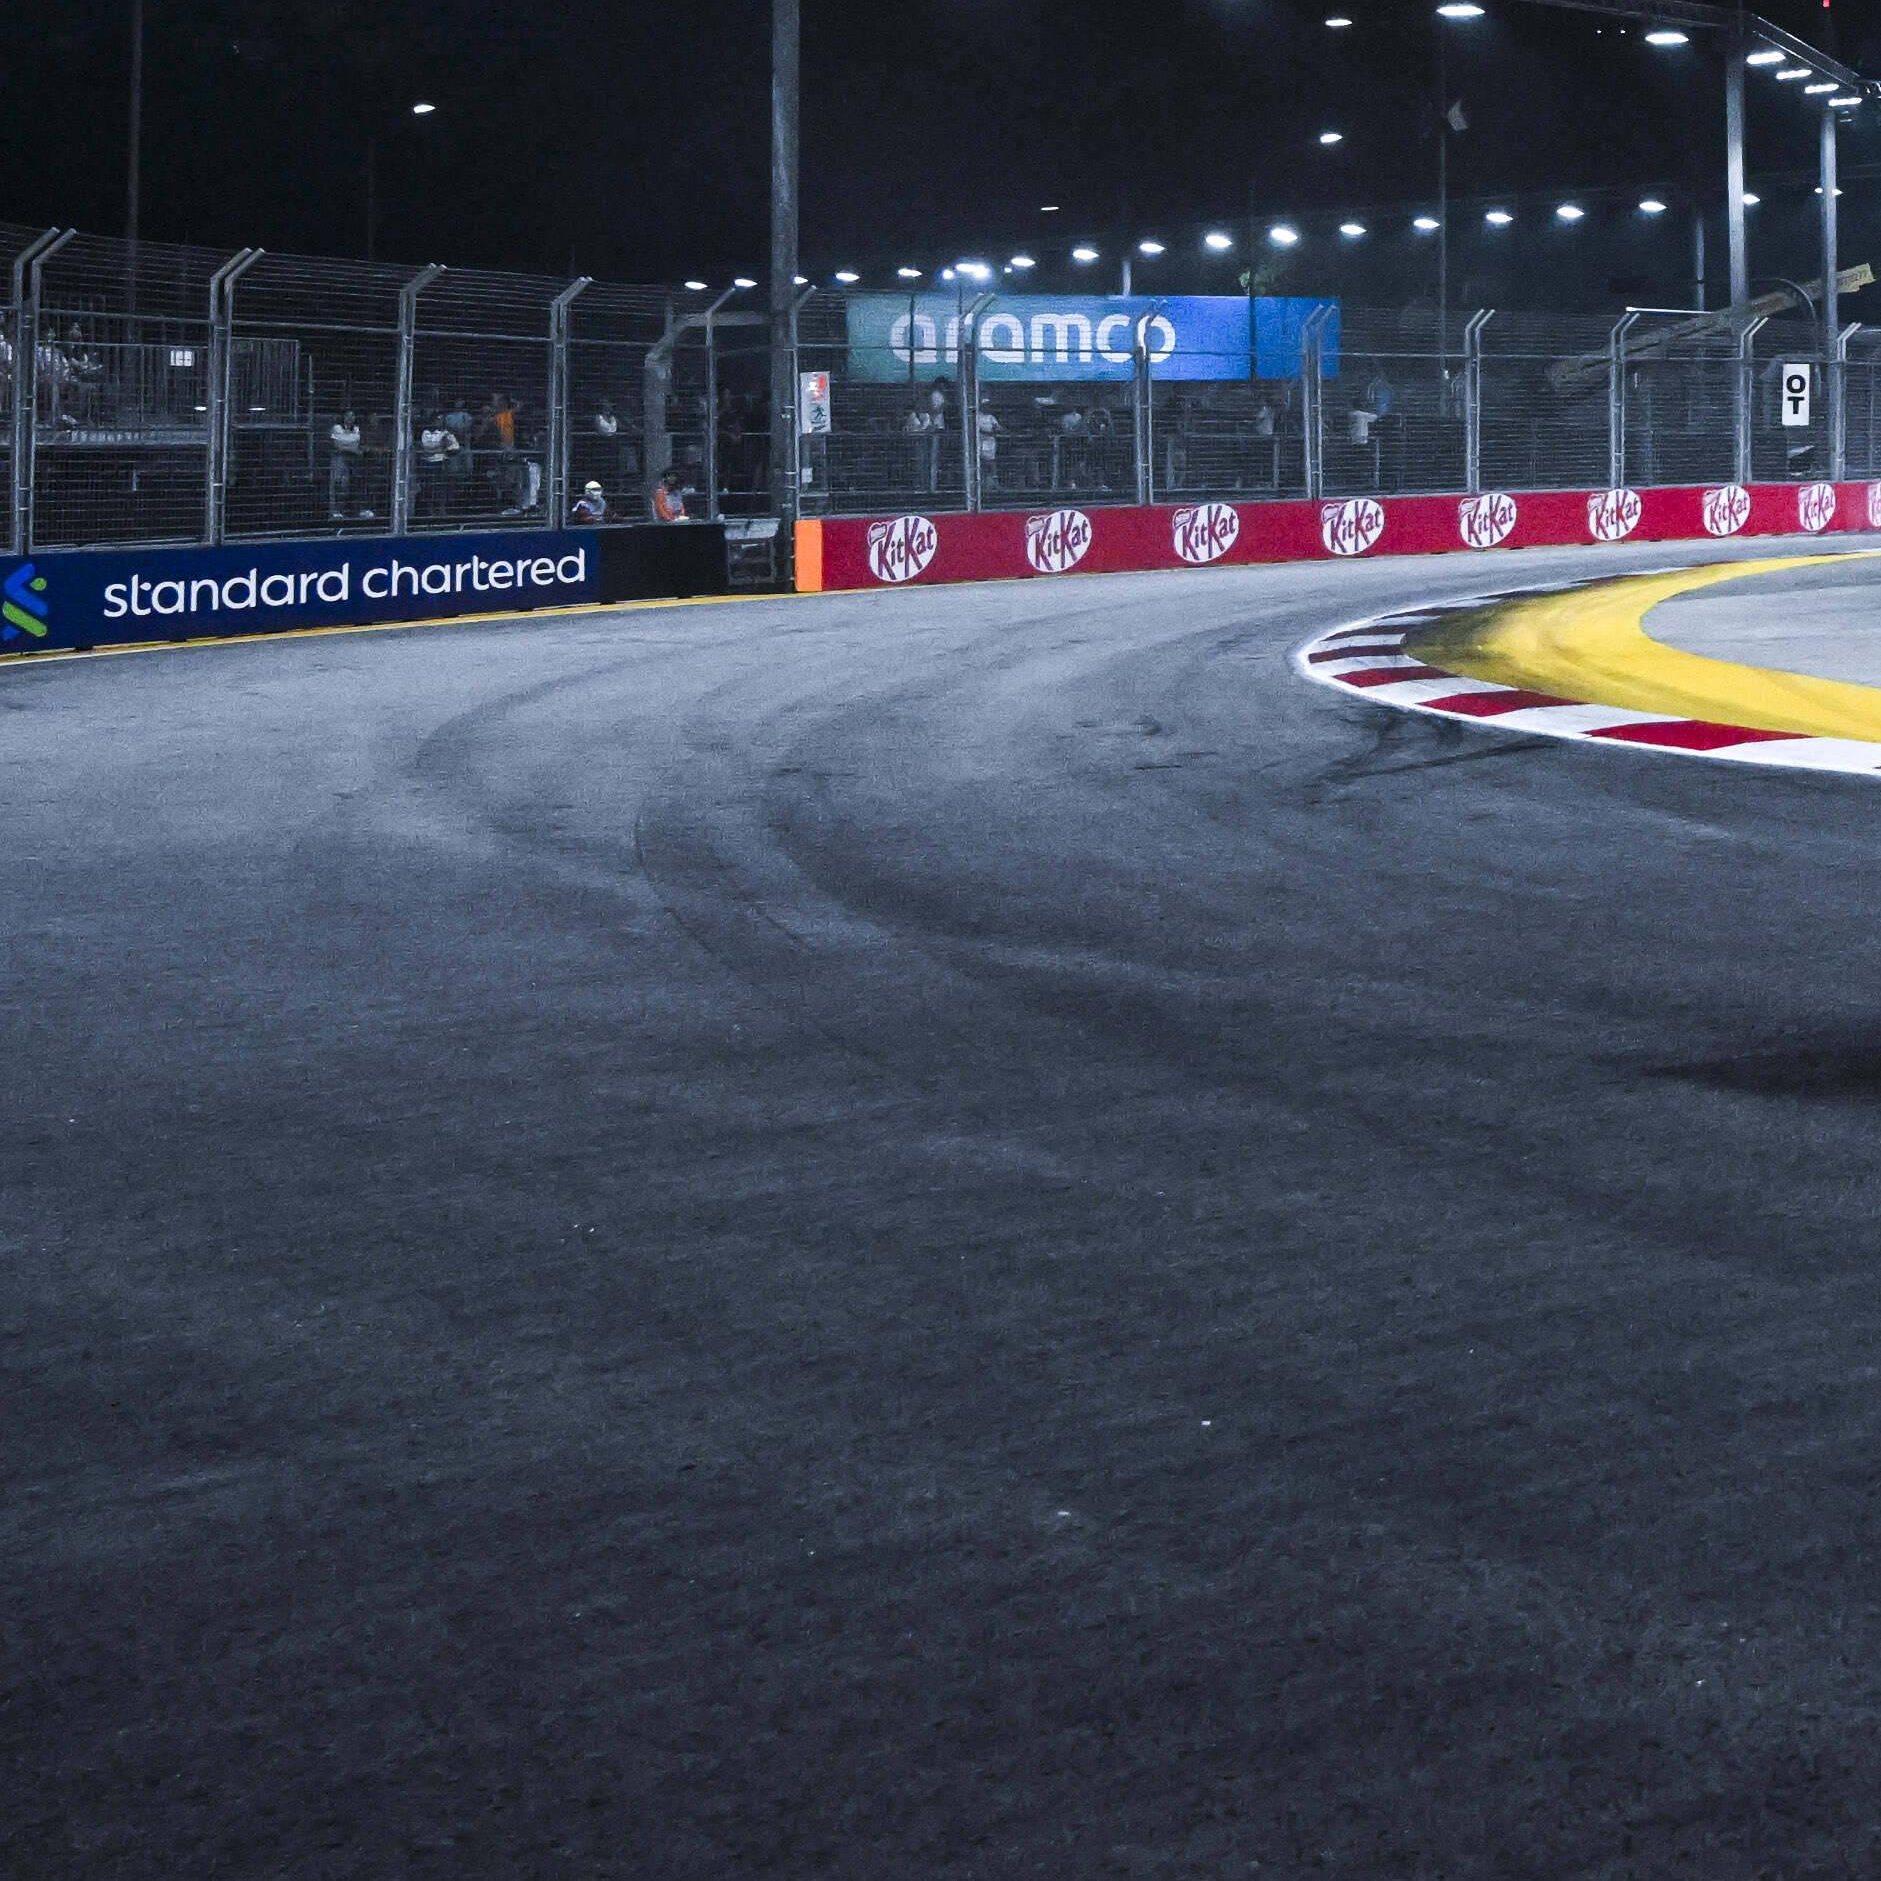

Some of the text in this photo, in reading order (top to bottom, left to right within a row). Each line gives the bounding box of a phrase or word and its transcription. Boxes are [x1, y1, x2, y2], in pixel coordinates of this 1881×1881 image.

[889, 313, 1176, 363] aramco
[1181, 505, 1236, 561] KitKat
[1330, 500, 1381, 554] KitKat
[1466, 494, 1514, 546] KitKat
[1594, 490, 1639, 540] KitKat
[1710, 486, 1748, 534] KitKat
[877, 517, 934, 581] KitKat
[1034, 512, 1088, 572] KitKat
[103, 547, 586, 618] standard chartered
